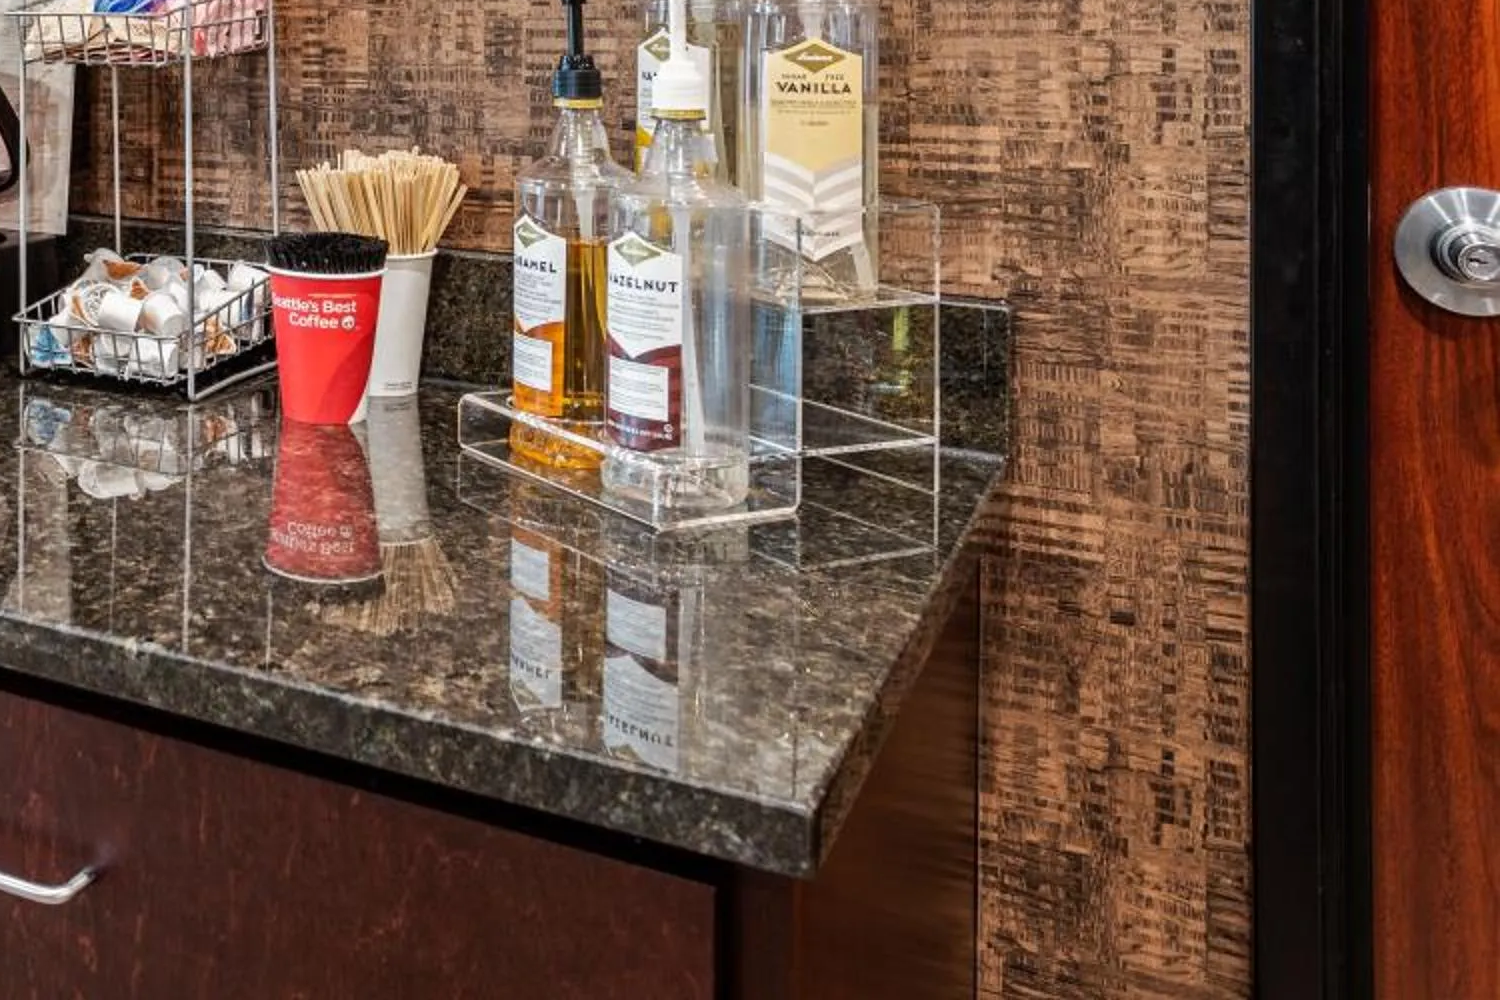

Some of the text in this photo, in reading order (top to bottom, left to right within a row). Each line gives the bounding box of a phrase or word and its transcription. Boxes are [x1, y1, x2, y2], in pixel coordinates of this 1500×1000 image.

[775, 81, 851, 95] VANILLA
[322, 300, 357, 313] Best
[289, 311, 339, 329] Coffee
